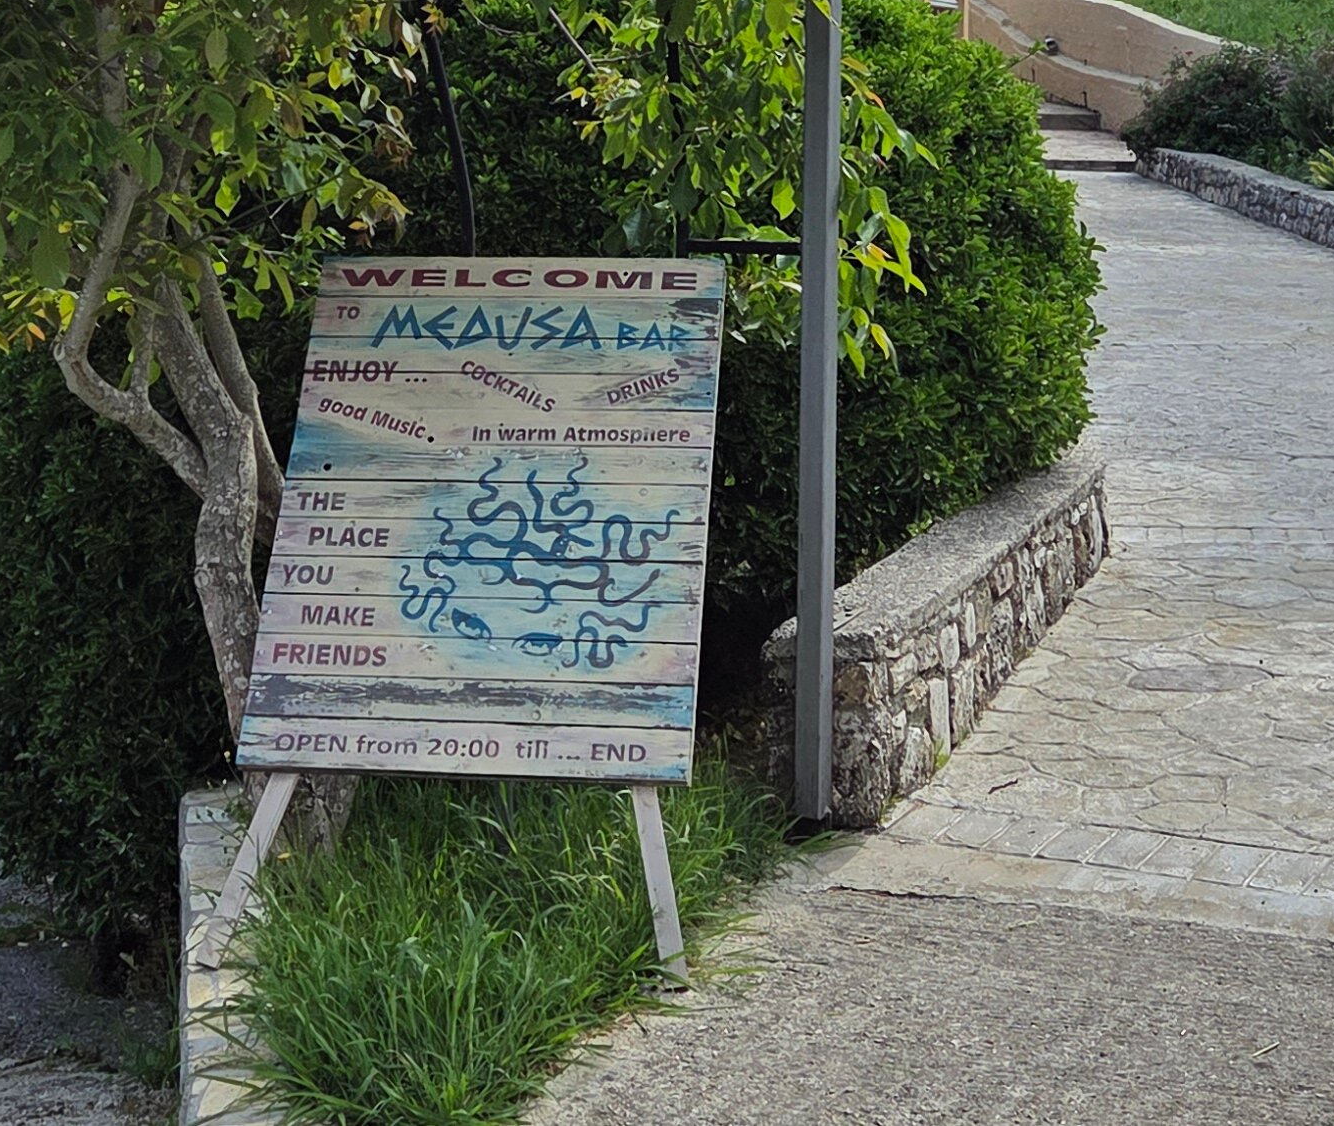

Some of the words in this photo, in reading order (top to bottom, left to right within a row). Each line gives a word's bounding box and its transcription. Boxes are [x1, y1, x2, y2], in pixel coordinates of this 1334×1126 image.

[341, 268, 699, 291] WELCOME
[336, 305, 361, 320] TO
[370, 304, 602, 351] MEDUSA
[616, 321, 692, 352] BAR
[312, 359, 399, 383] ENJOY
[460, 360, 556, 413] COCKTAILS
[606, 368, 681, 405] DRINKS
[318, 396, 368, 422] good
[472, 425, 491, 442] In
[498, 427, 557, 442] warm
[562, 426, 691, 444] Atmosphere
[298, 492, 346, 511] THE
[307, 527, 391, 548] PLACE
[282, 564, 334, 586] YOU
[300, 606, 375, 627] MAKE
[272, 643, 387, 667] FRIENDS
[275, 733, 347, 754] OPEN
[356, 734, 418, 755] from
[427, 738, 500, 758] 20:00
[591, 743, 647, 762] END
